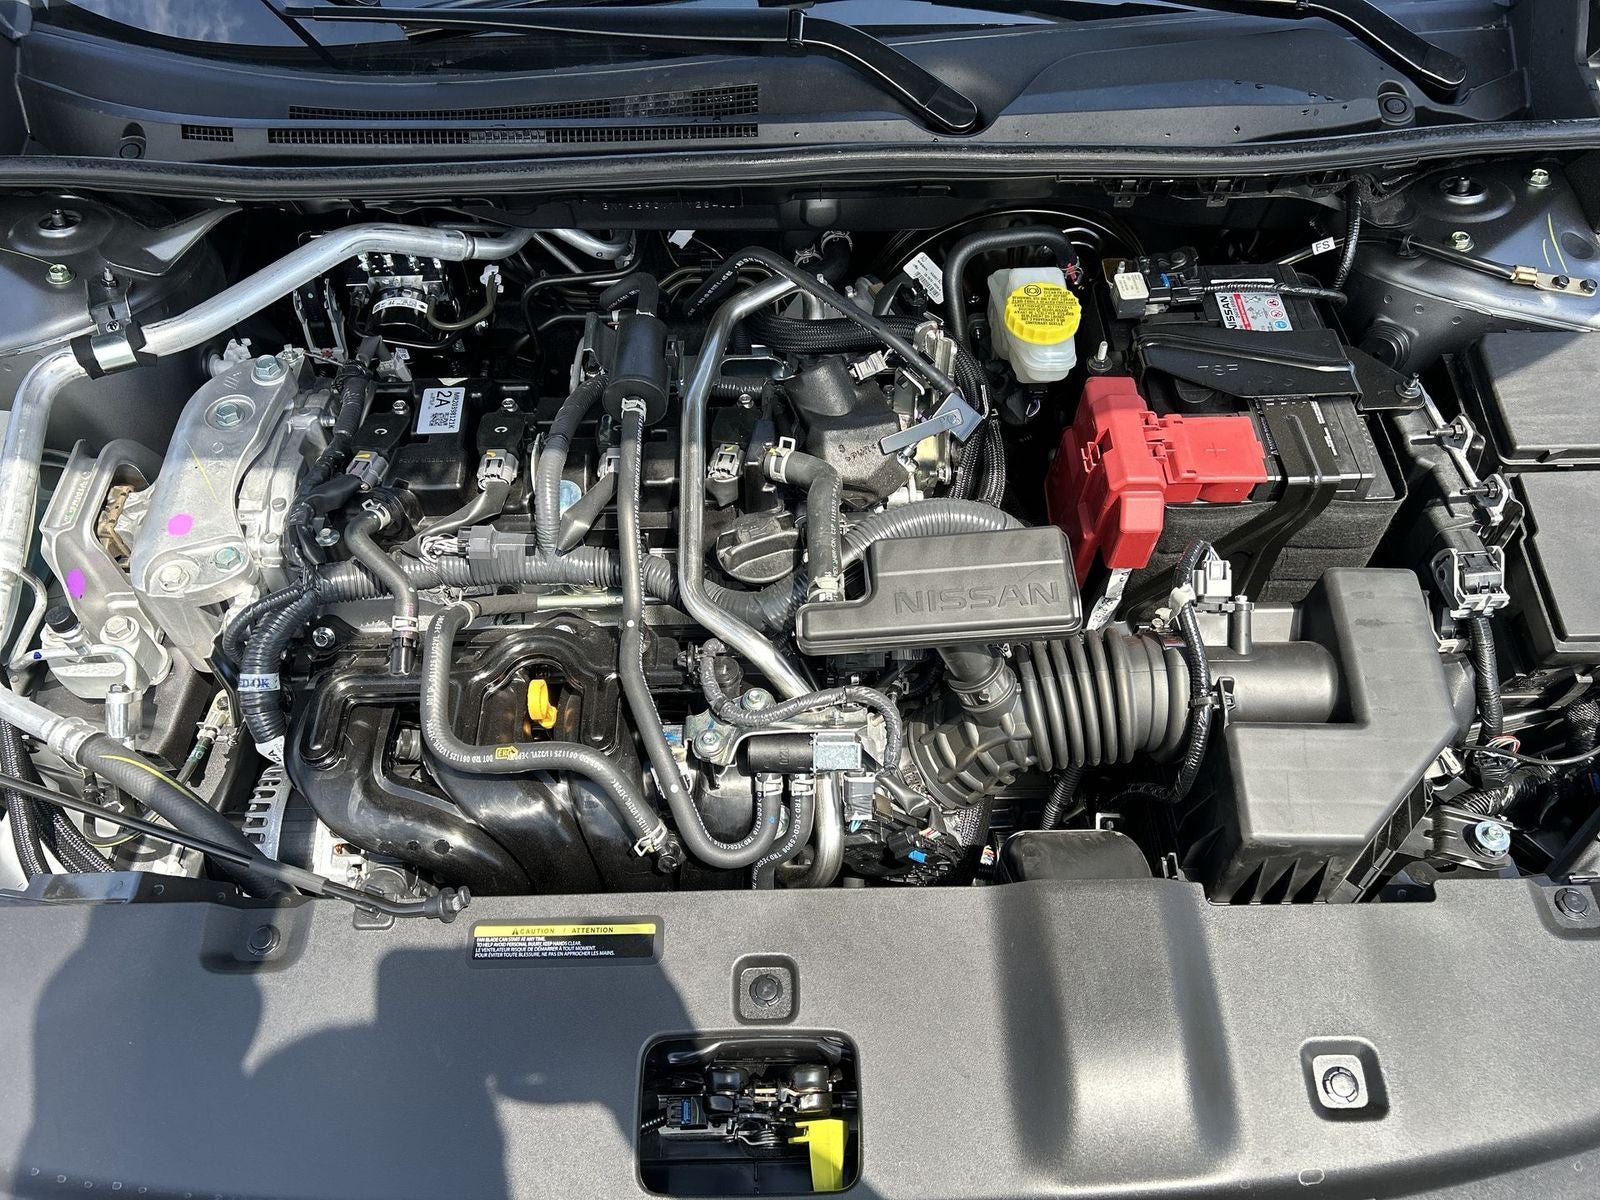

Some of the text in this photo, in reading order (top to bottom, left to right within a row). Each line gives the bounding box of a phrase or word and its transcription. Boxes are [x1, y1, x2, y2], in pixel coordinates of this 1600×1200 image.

[1315, 241, 1331, 252] FS
[1219, 295, 1237, 329] NISSAN
[434, 390, 453, 408] 2A
[893, 581, 1061, 615] NISSAN
